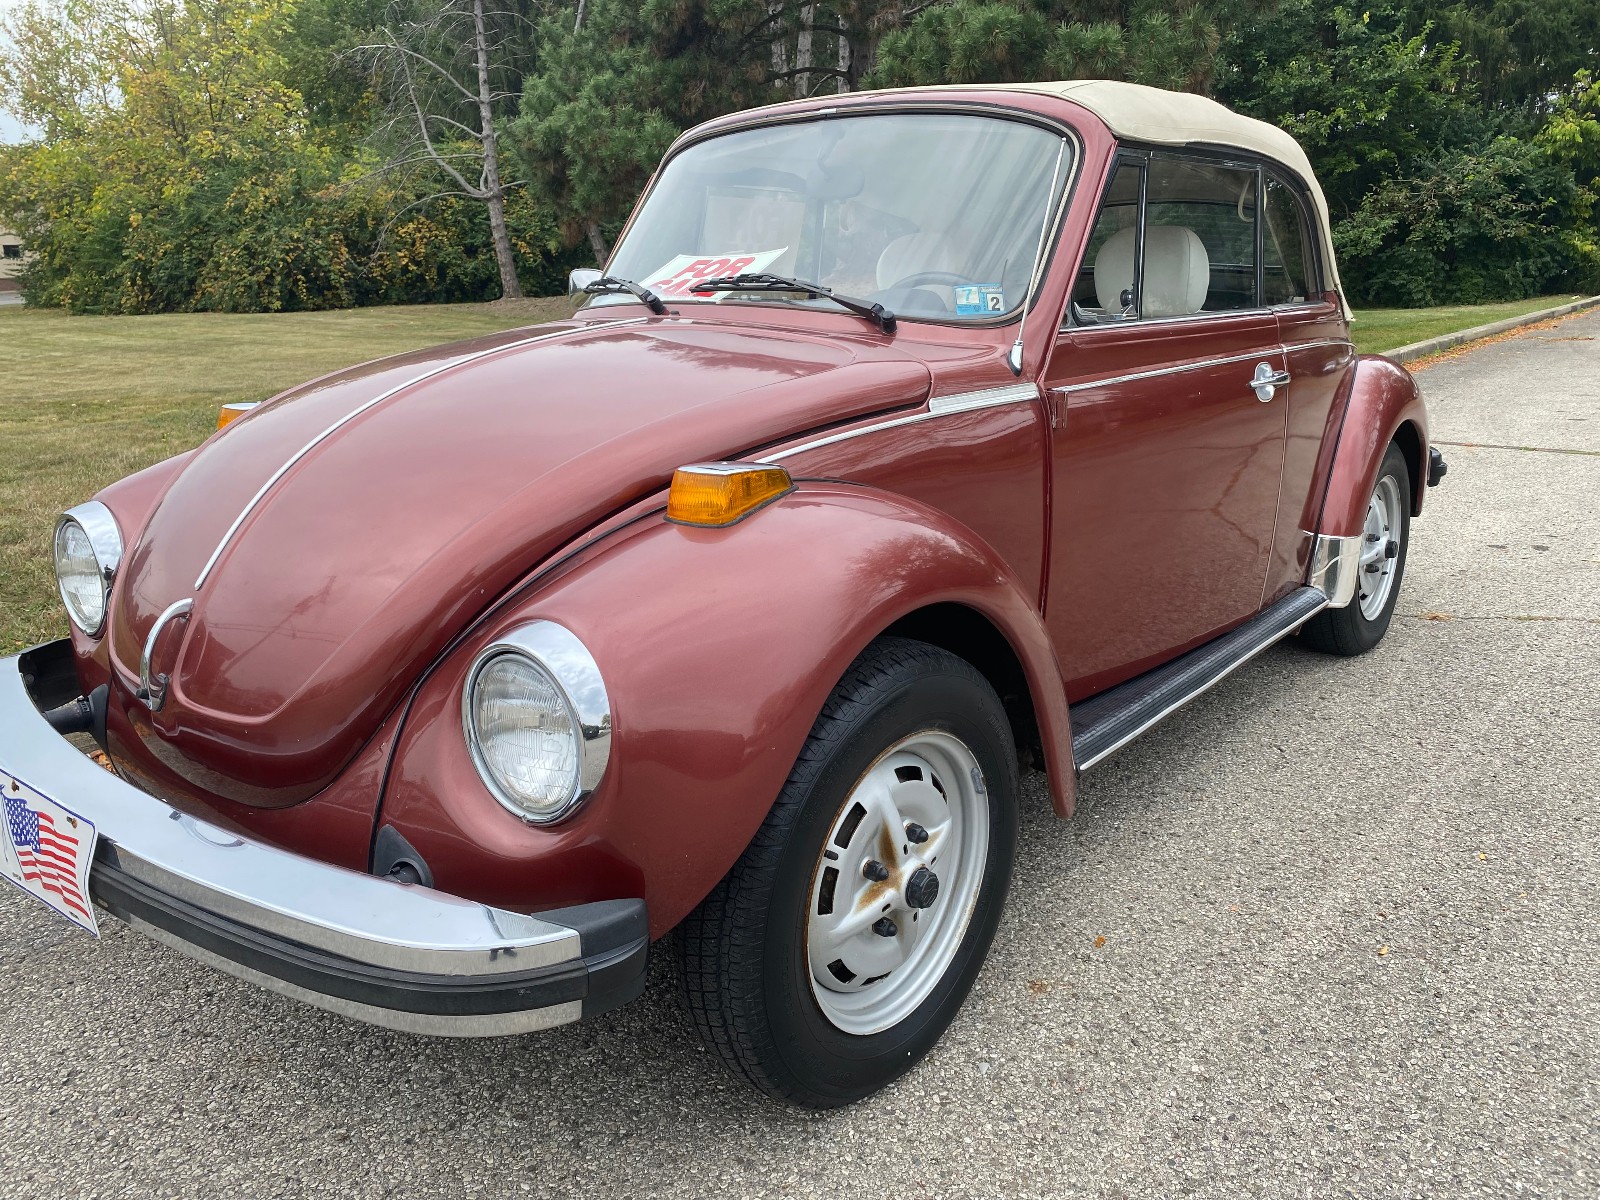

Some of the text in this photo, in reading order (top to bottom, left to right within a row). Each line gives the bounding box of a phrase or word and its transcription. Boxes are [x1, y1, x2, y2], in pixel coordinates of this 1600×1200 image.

[673, 256, 756, 279] FOR
[961, 289, 973, 301] 7
[990, 296, 1001, 311] 2
